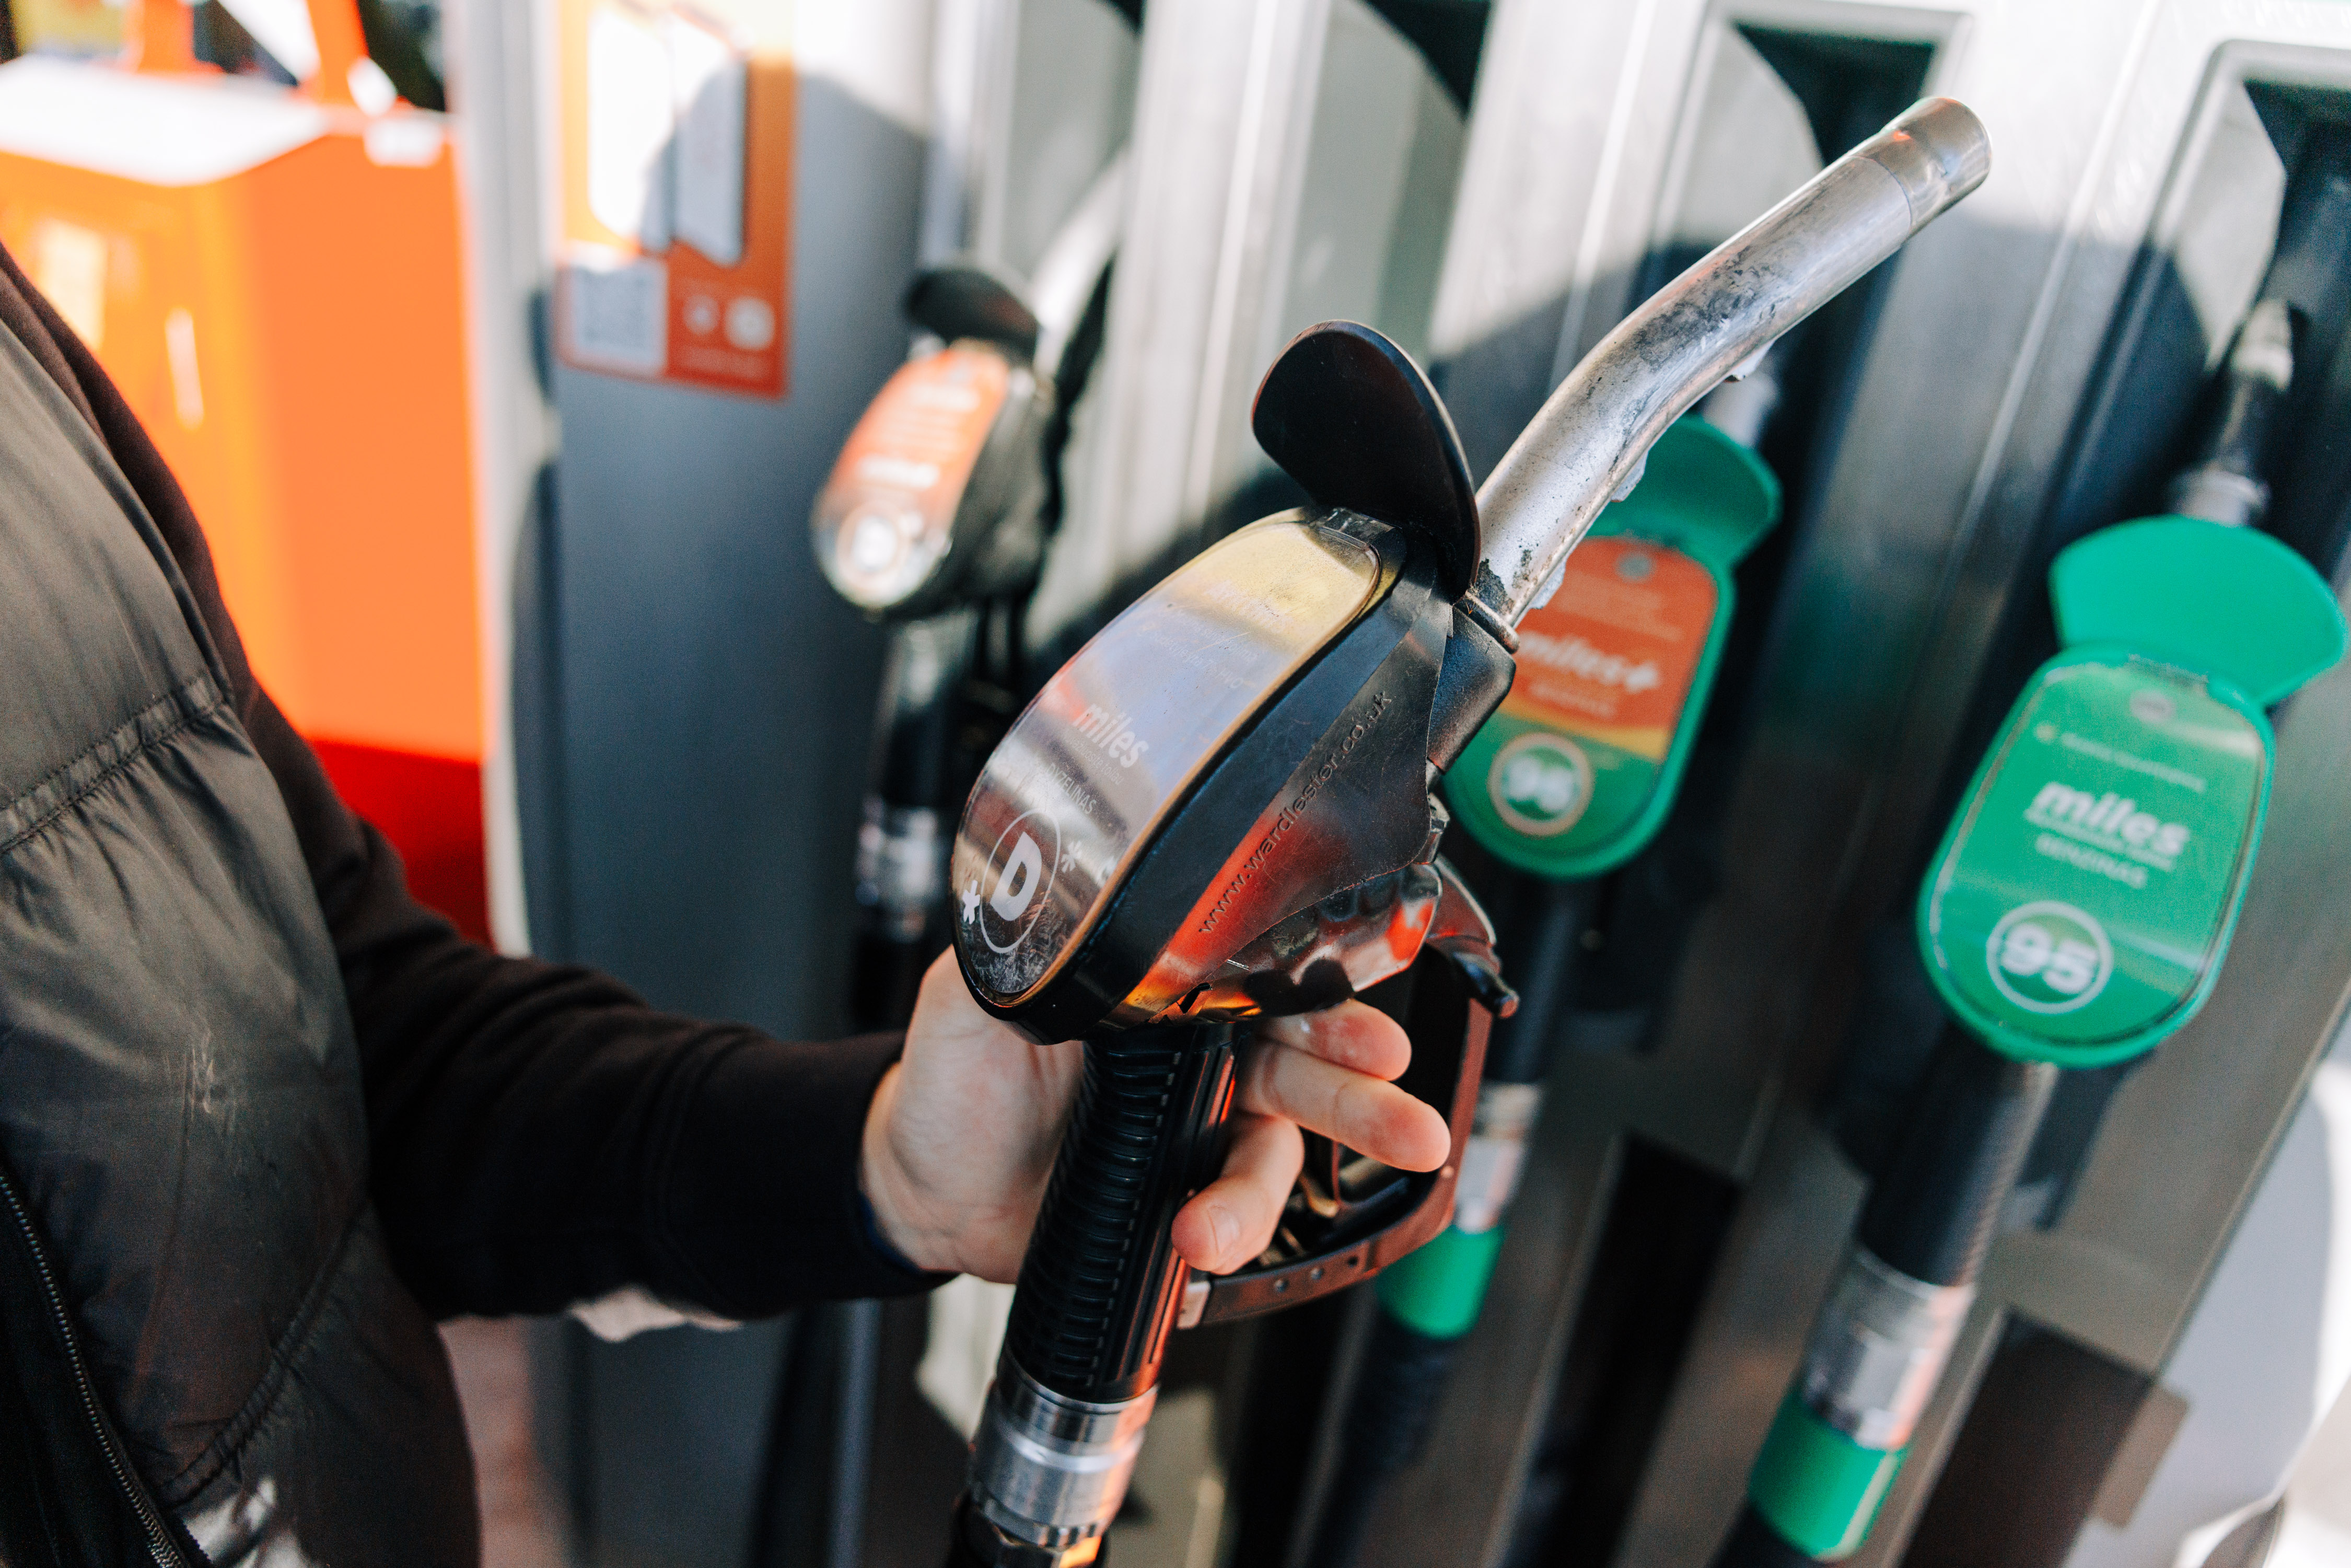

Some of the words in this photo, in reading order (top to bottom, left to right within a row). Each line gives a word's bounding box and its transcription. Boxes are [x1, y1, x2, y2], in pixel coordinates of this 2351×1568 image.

[1215, 668, 1244, 689] HVO
[1072, 703, 1149, 768] miles
[1046, 762, 1097, 814] DYZELINAS
[1101, 762, 1123, 785] toliau
[1199, 690, 1392, 935] www.wardlester.co.uk
[2031, 782, 2189, 856] miles
[991, 831, 1042, 922] D
[2000, 923, 2098, 995] 95
